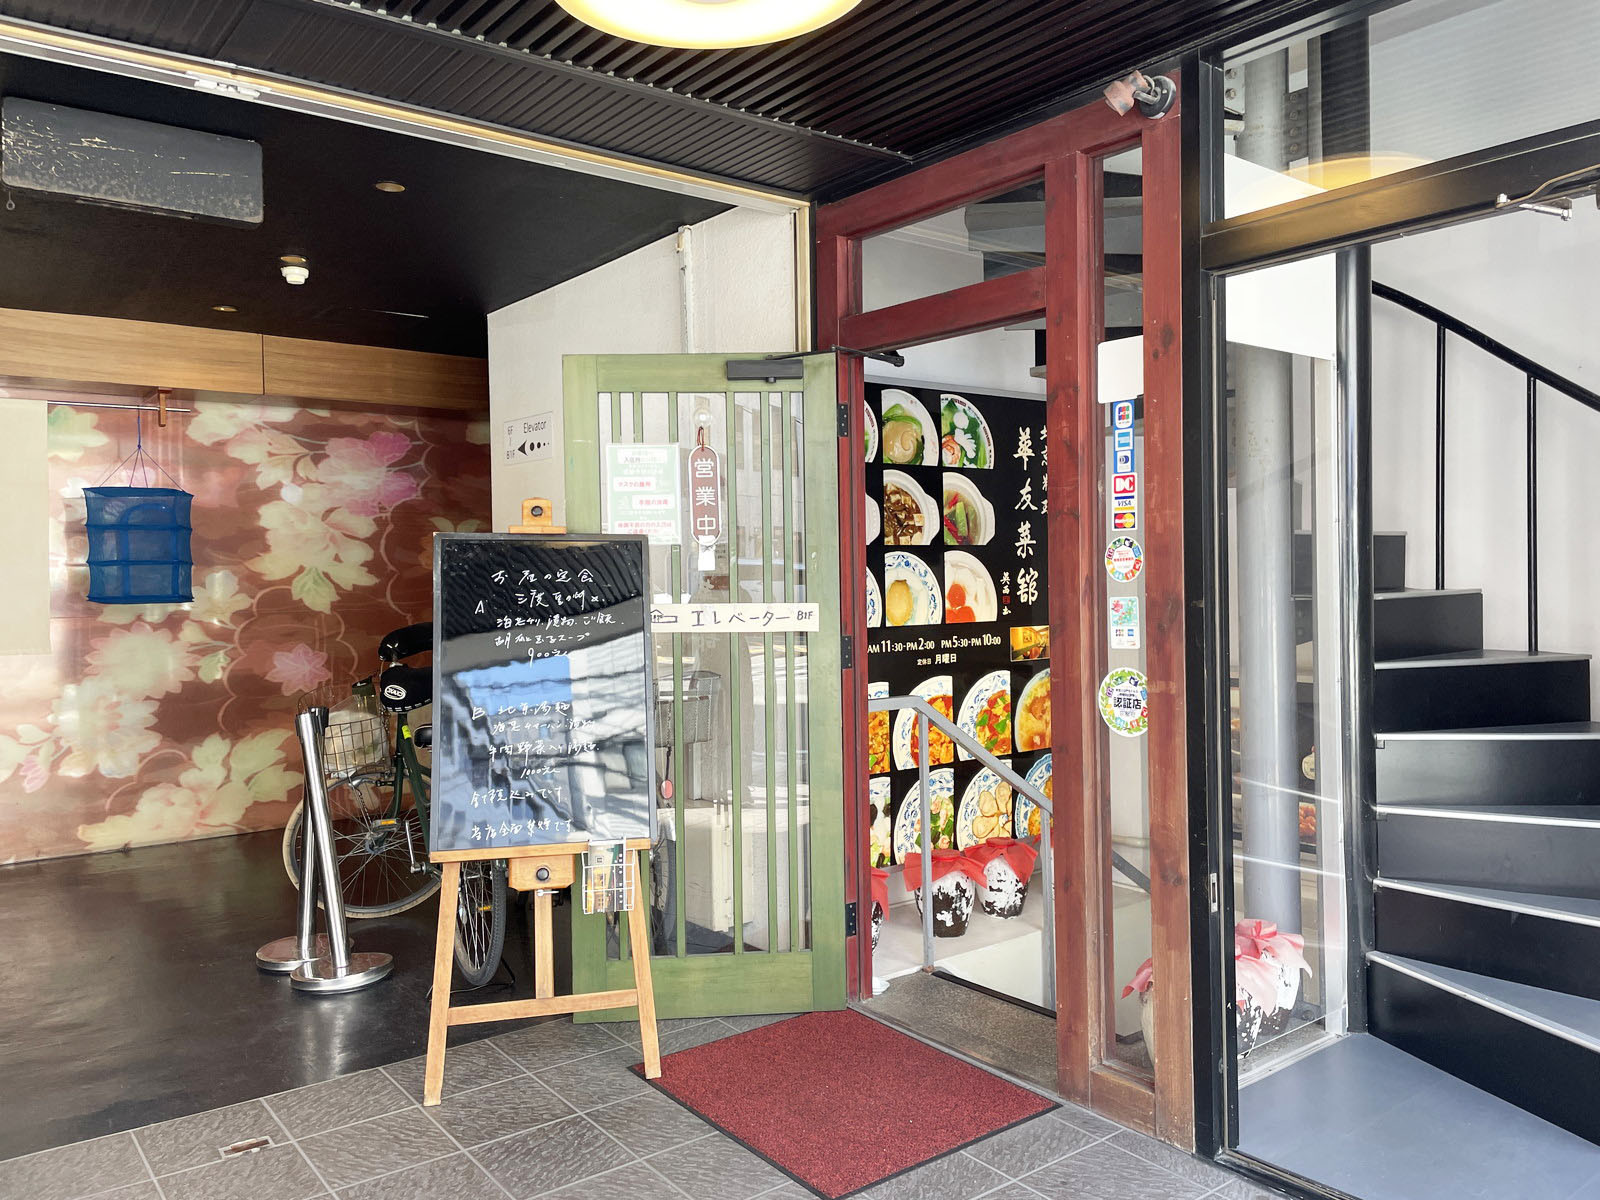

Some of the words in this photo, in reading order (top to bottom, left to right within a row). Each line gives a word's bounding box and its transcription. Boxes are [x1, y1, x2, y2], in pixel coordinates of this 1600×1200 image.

[523, 421, 547, 434] Elevator
[1115, 477, 1134, 492] DC
[694, 457, 716, 535] 営業中
[474, 600, 485, 615] A
[691, 610, 790, 627] エレベーター
[796, 610, 813, 621] B1F
[917, 658, 932, 666] 定休日
[934, 653, 957, 665] 月曜日
[1113, 696, 1142, 710] 認証店
[471, 705, 486, 720] B
